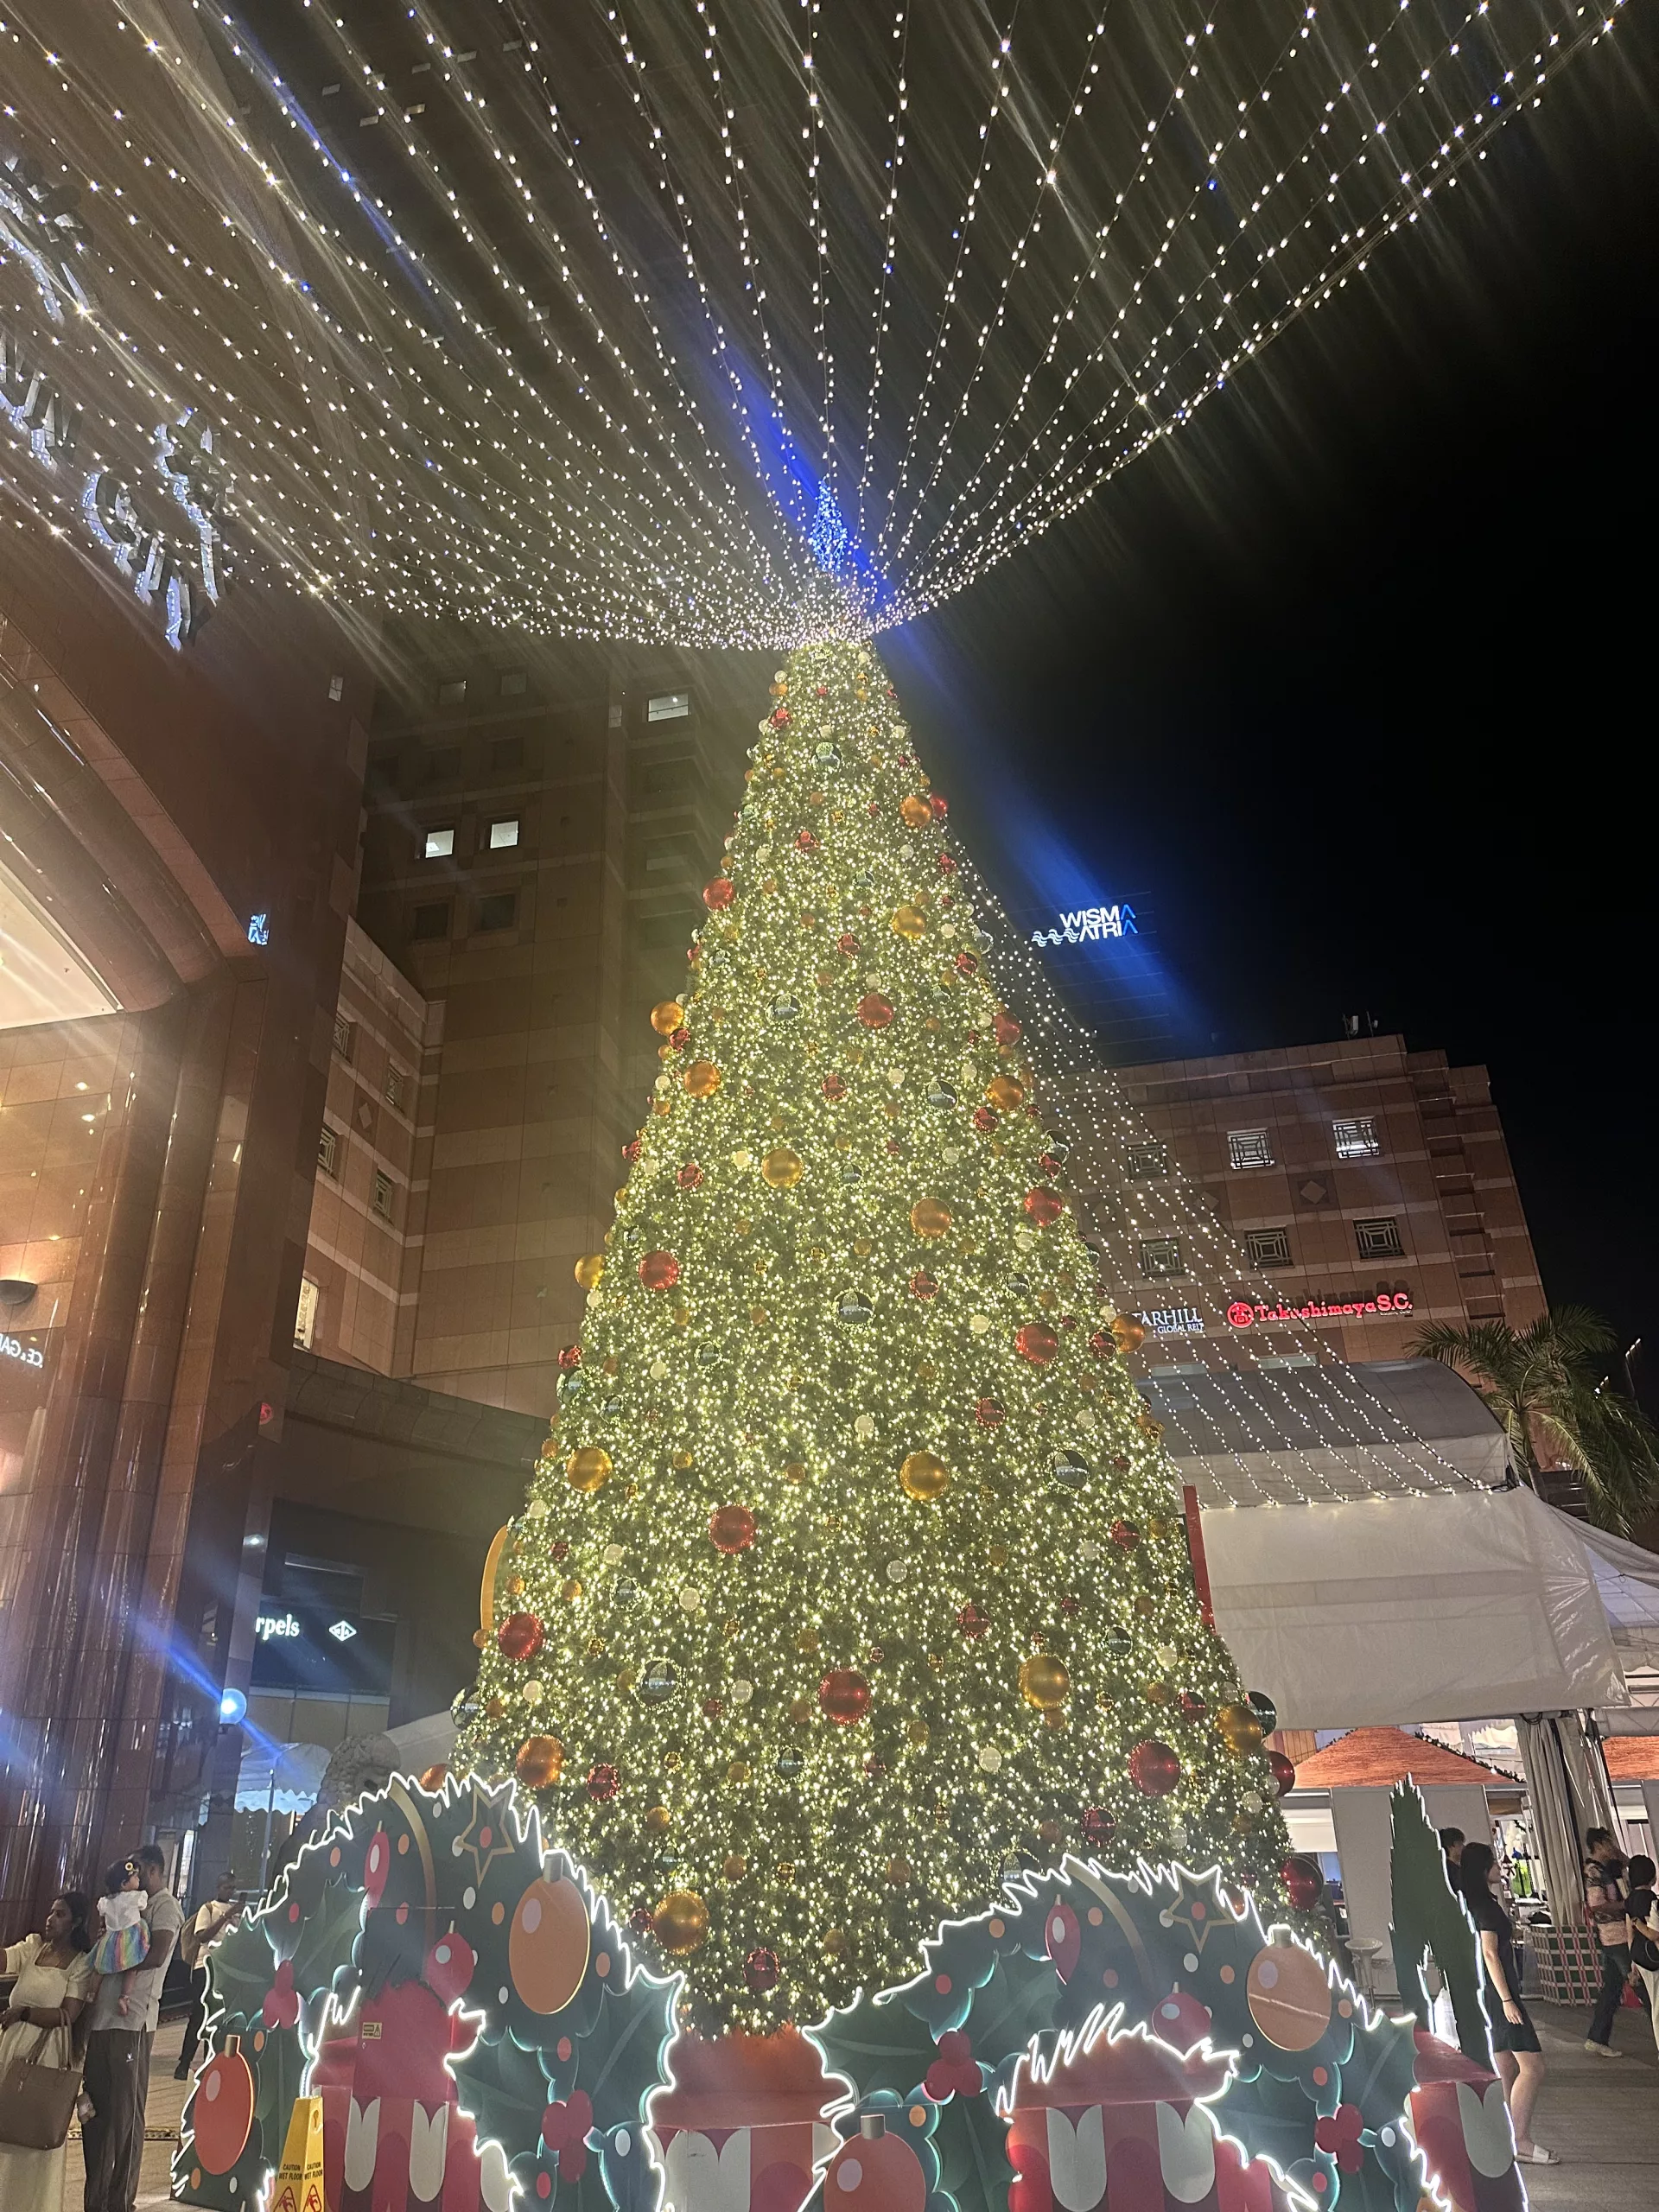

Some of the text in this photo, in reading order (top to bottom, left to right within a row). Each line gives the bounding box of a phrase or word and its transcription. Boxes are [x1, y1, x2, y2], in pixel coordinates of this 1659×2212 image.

[1059, 904, 1136, 929] WISMA
[1079, 919, 1139, 943] ATRIA
[1254, 1300, 1377, 1322] Takashimaya
[1157, 1324, 1186, 1334] GLOBAL
[255, 1613, 301, 1641] rpels
[289, 2172, 302, 2181] FLOOR
[307, 2162, 321, 2171] CAUTION
